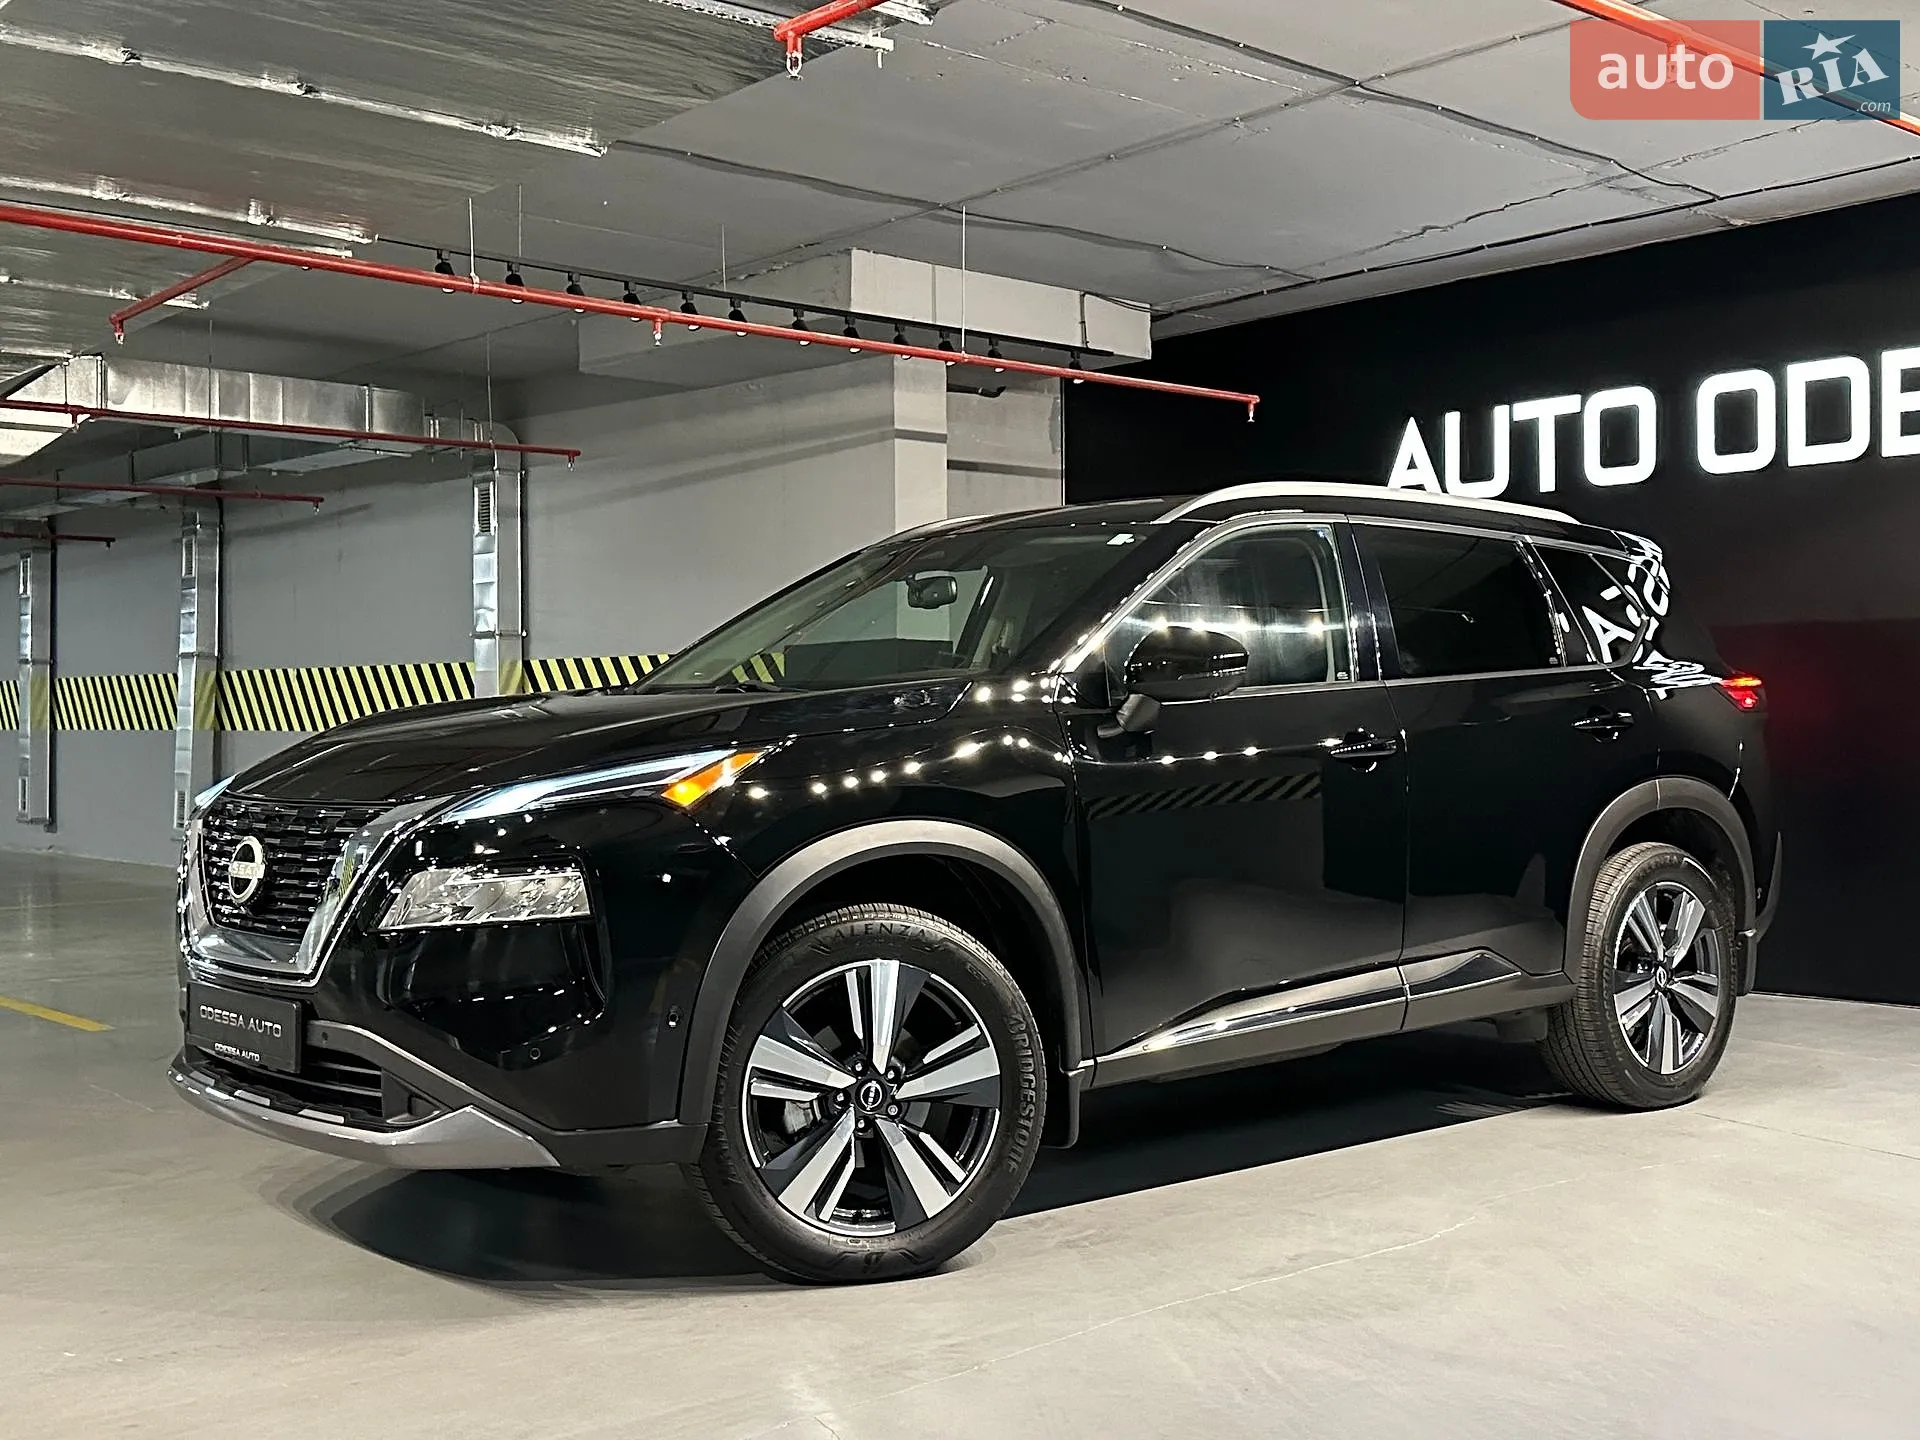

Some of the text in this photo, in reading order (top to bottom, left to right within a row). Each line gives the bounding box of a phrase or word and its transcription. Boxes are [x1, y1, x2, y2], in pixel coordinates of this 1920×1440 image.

[1386, 385, 1658, 499] AUTO
[199, 1004, 282, 1038] ODESSA AUTO
